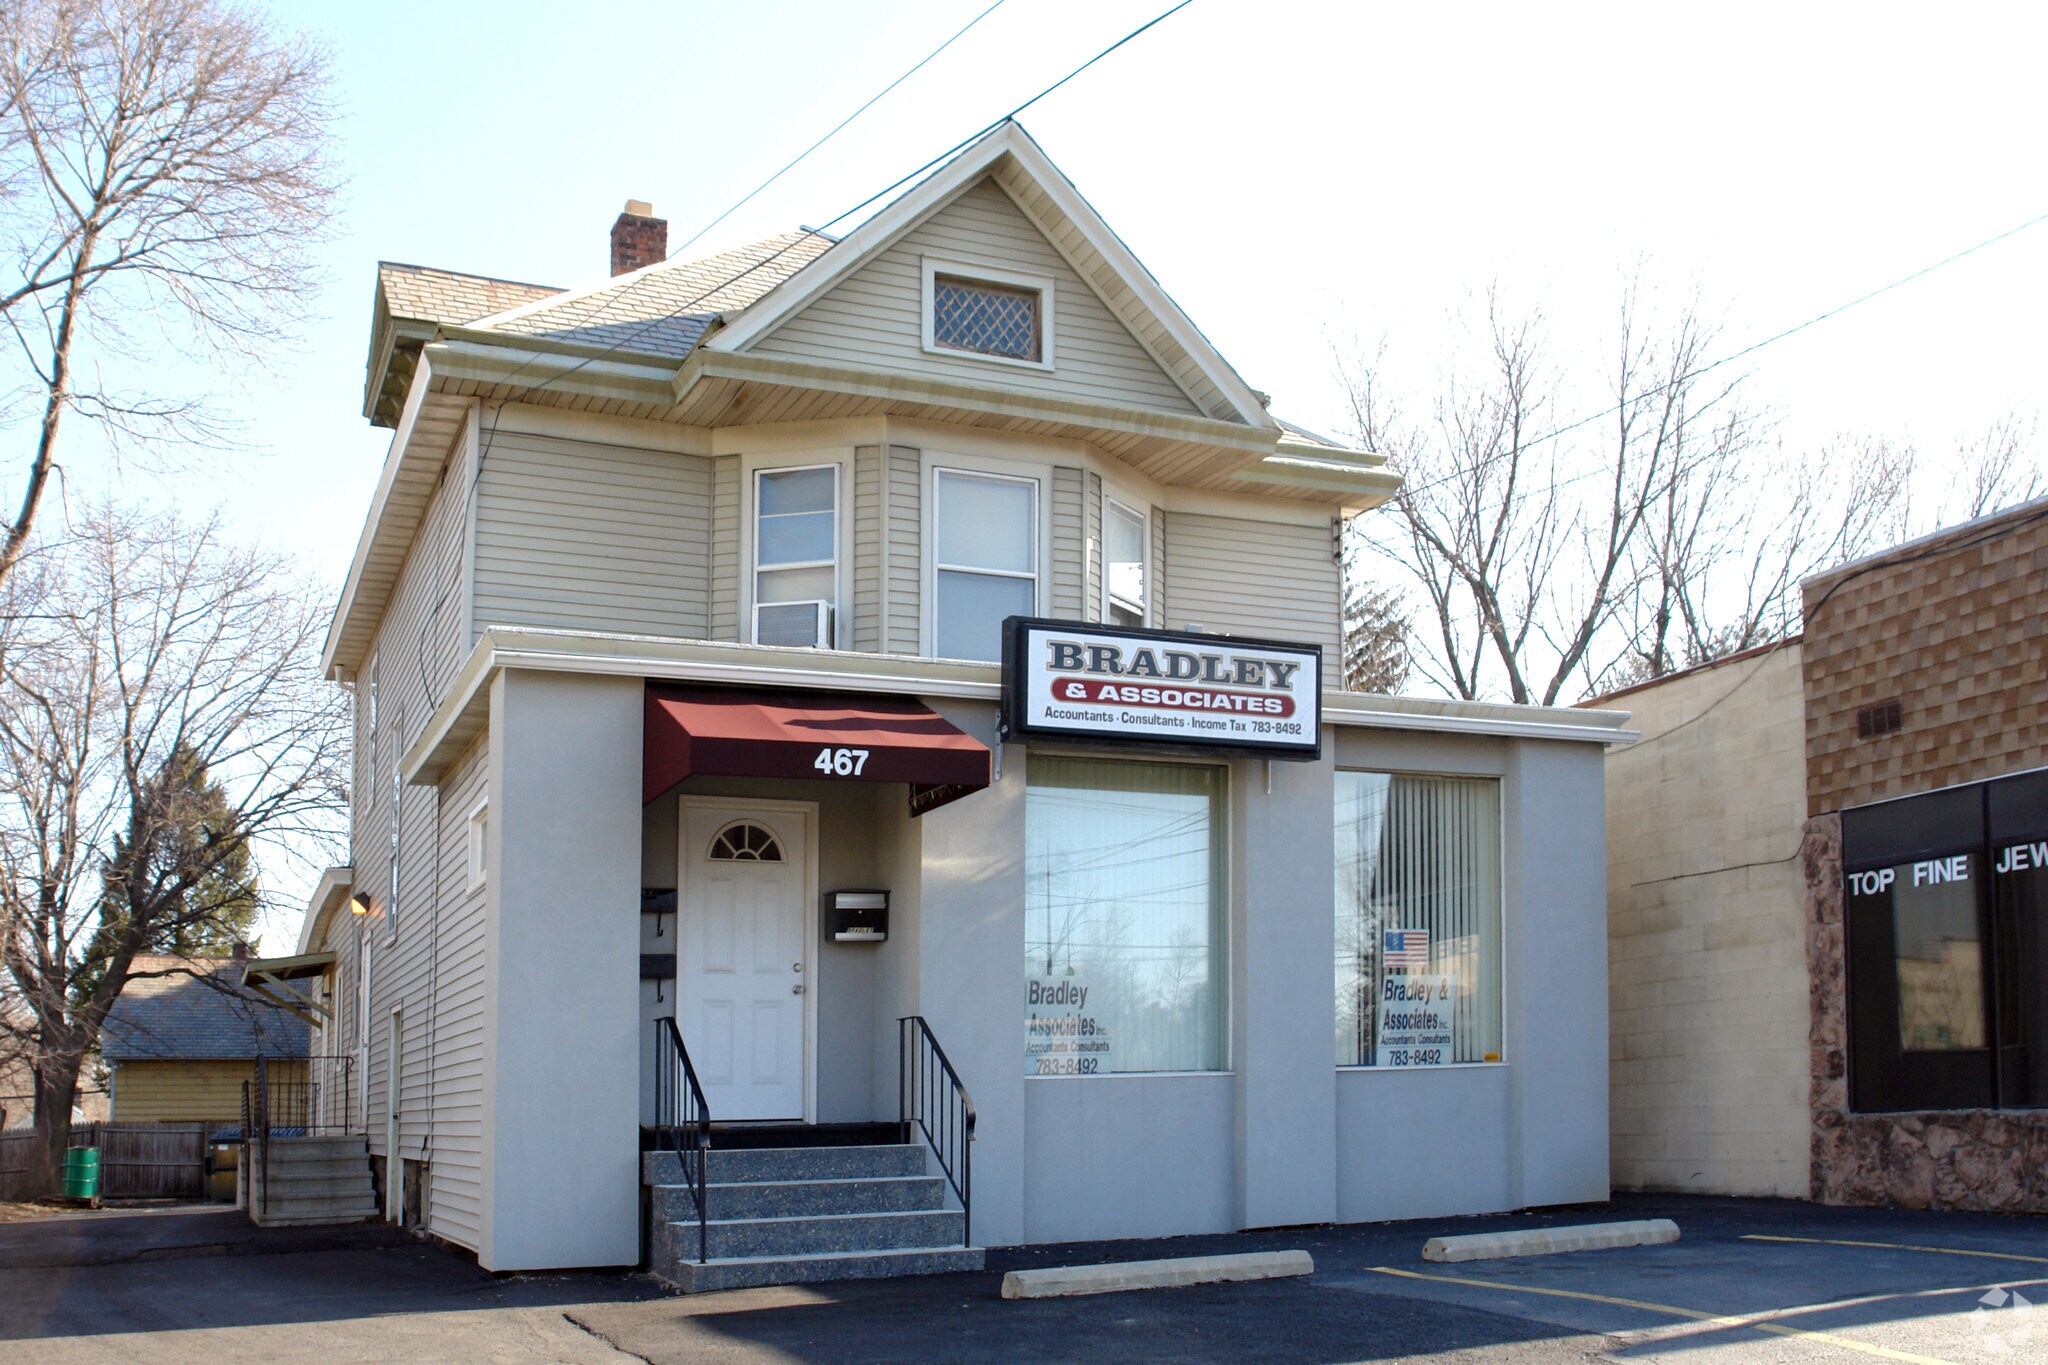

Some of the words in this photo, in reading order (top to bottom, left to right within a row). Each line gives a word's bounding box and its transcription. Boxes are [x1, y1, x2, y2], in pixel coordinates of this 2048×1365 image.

[1047, 640, 1300, 690] BRADLEY
[1065, 683, 1087, 699] &
[1098, 685, 1283, 714] ASSOCIATES
[1045, 706, 1114, 723] Accountants
[1121, 712, 1185, 728] Consultants
[1192, 717, 1227, 731] Income
[1230, 720, 1246, 732] Tax
[1252, 721, 1302, 735] 783-8492
[814, 748, 869, 776] 467
[1849, 868, 1895, 896] TOP
[1913, 855, 1969, 887] FINE
[1996, 841, 2048, 874] JEW
[1029, 980, 1088, 1010] Bradley
[1384, 979, 1433, 1005] Bradley
[1439, 979, 1449, 1001] &
[1029, 1012, 1096, 1037] Associates
[1382, 1008, 1438, 1031] Associates
[1070, 1040, 1110, 1053] Consultants
[1381, 1035, 1416, 1046] Accountants
[1418, 1033, 1451, 1045] Consultants
[1036, 1058, 1098, 1075] 783-8492
[1389, 1049, 1441, 1066] 783-8492
